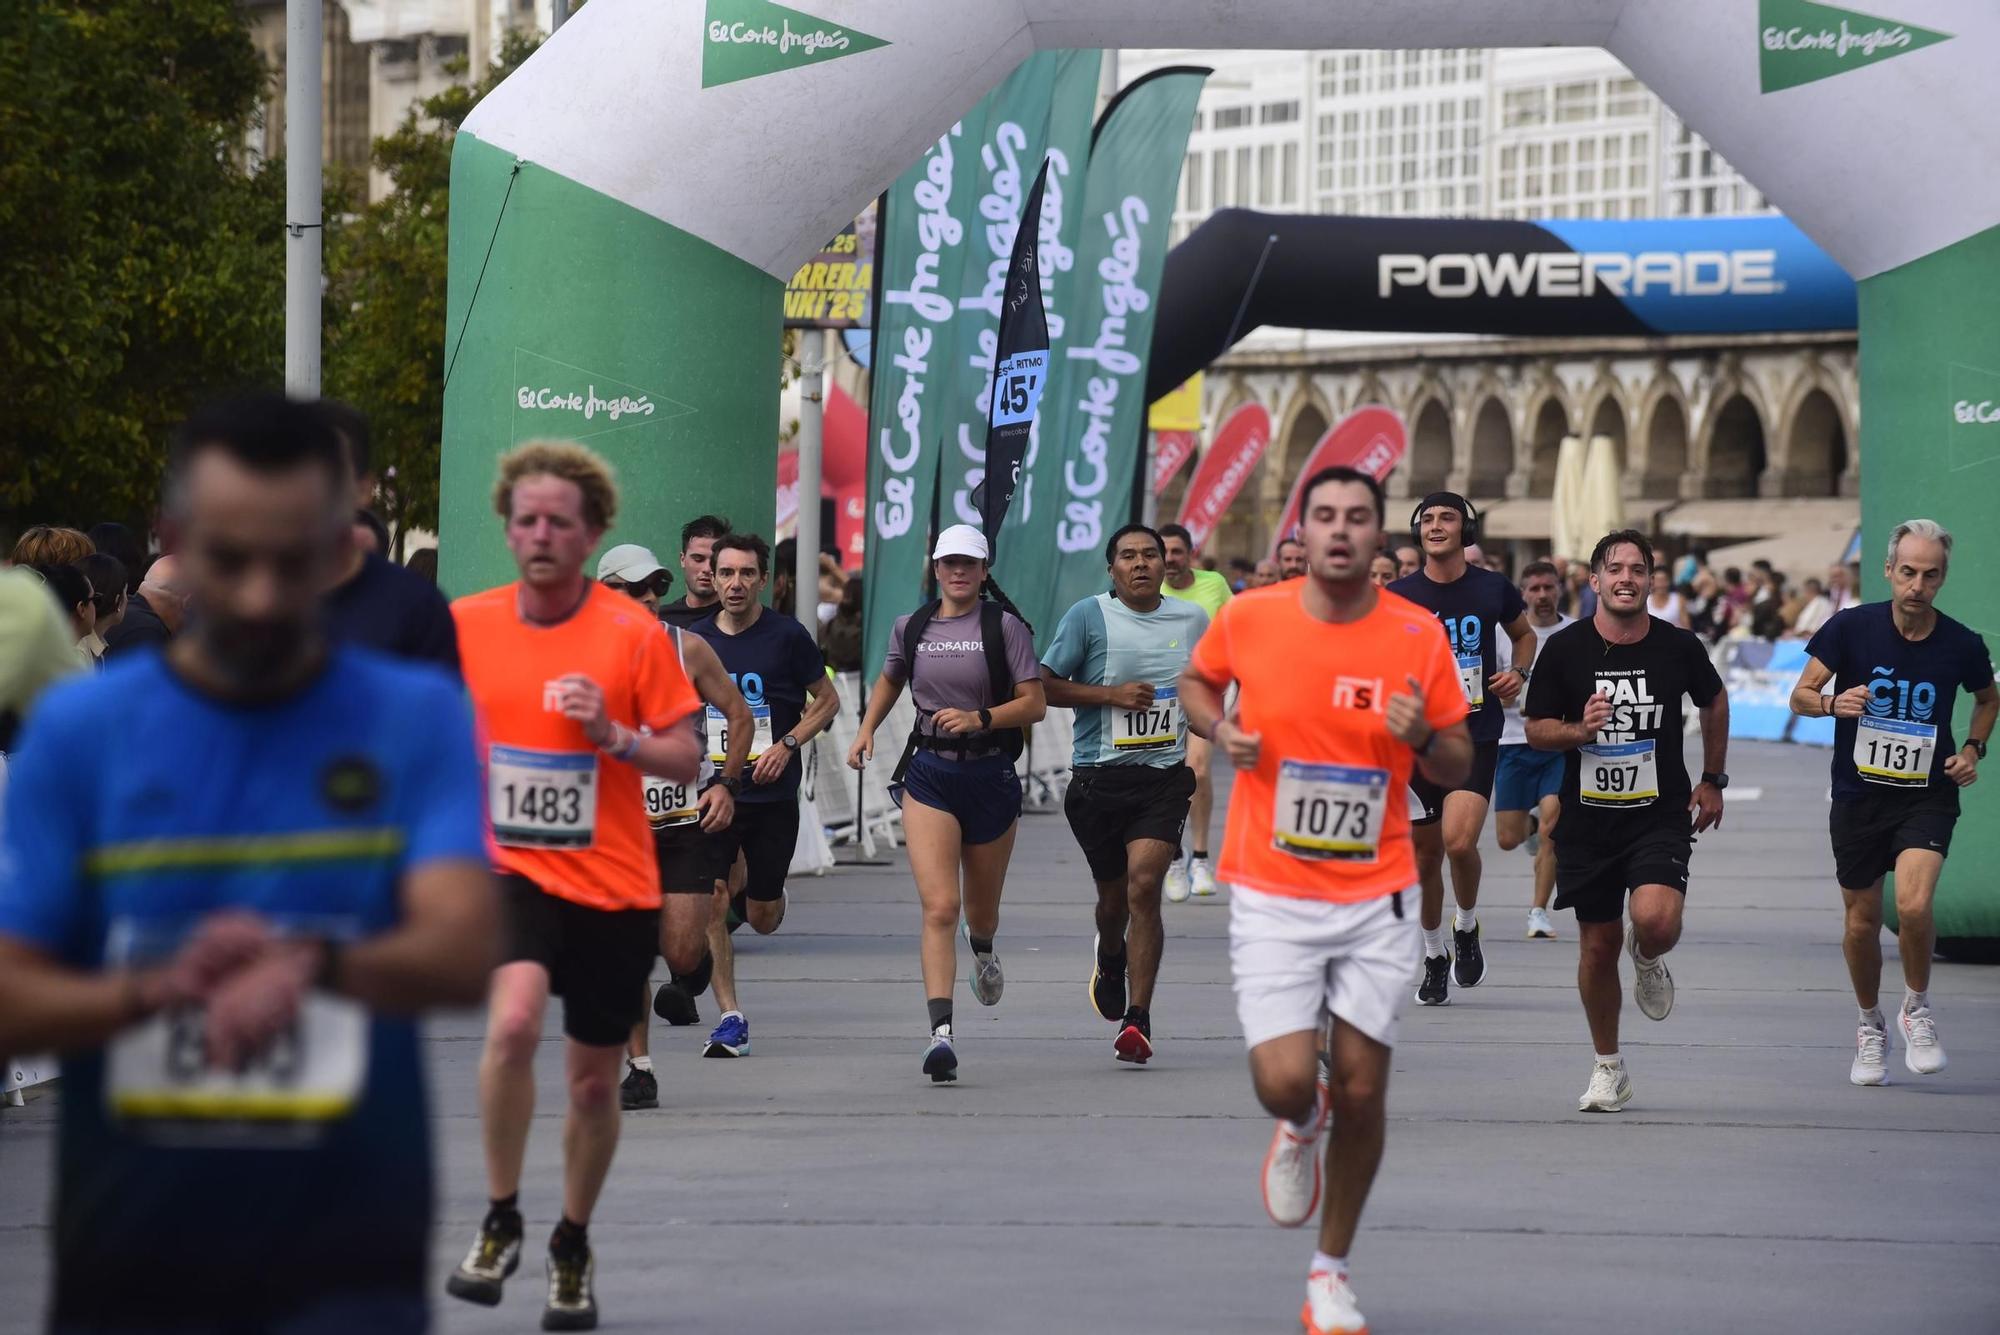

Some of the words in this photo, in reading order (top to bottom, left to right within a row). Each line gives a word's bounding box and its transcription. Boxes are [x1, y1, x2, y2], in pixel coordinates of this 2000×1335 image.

[708, 20, 729, 43] El
[729, 22, 777, 46] Corte
[779, 19, 850, 55] Inglés
[1763, 26, 1785, 50] El
[1785, 27, 1837, 50] Corte
[1836, 19, 1912, 58] Inglés
[820, 233, 857, 254] .25
[785, 262, 873, 289] RRERA
[1066, 195, 1150, 375] Inglés
[1378, 250, 1777, 298] POWERADE
[518, 386, 536, 408] El
[537, 388, 583, 411] Corte
[584, 384, 655, 420] Inglés
[880, 326, 933, 473] Corte
[1954, 400, 1976, 423] El
[1065, 376, 1119, 498] Corte
[875, 477, 915, 540] El
[1057, 500, 1103, 553] El
[1595, 677, 1655, 705] PAL
[1123, 709, 1171, 737] 1074
[1868, 740, 1922, 771] 1131
[1595, 765, 1639, 793] 997
[503, 783, 581, 825] 1483
[644, 785, 687, 813] 969
[1293, 796, 1370, 839] 1073
